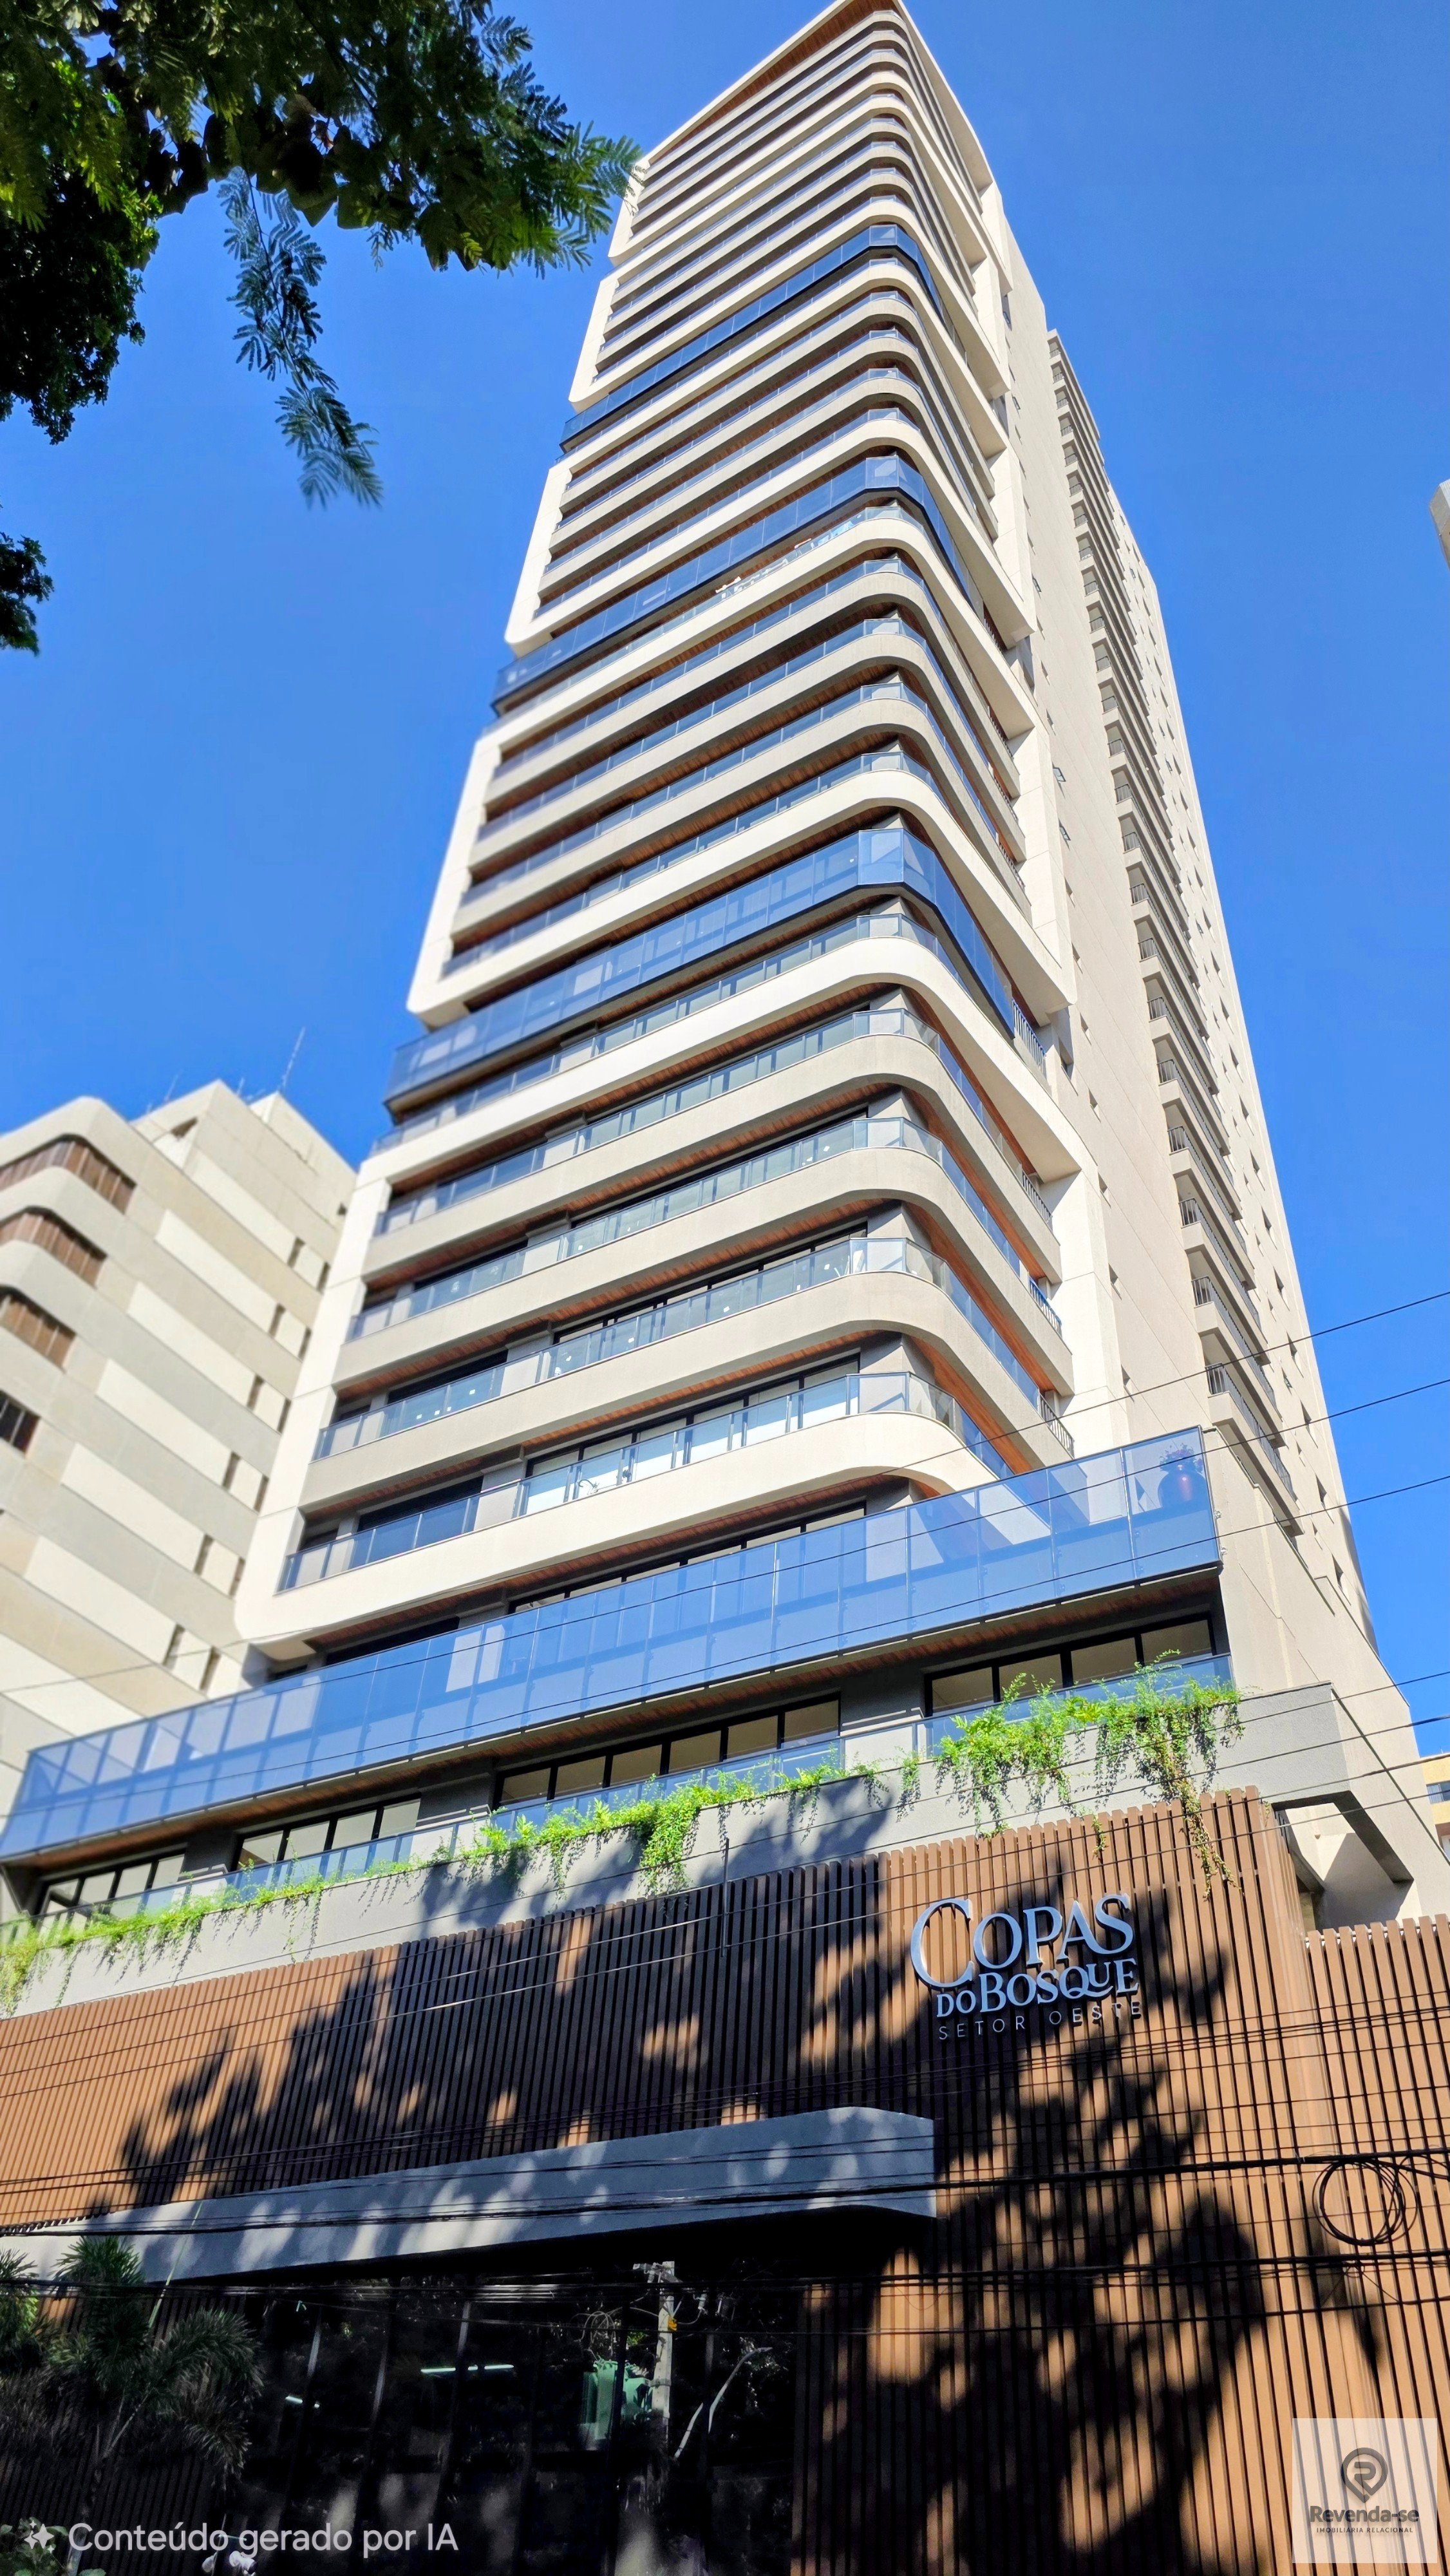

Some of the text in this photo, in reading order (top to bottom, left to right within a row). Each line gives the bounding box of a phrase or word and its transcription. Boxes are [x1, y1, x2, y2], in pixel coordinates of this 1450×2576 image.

[910, 1893, 1134, 1988] COPAS
[936, 1958, 1139, 2017] DO BOSQUE
[939, 2000, 1142, 2040] SETOR OESTE
